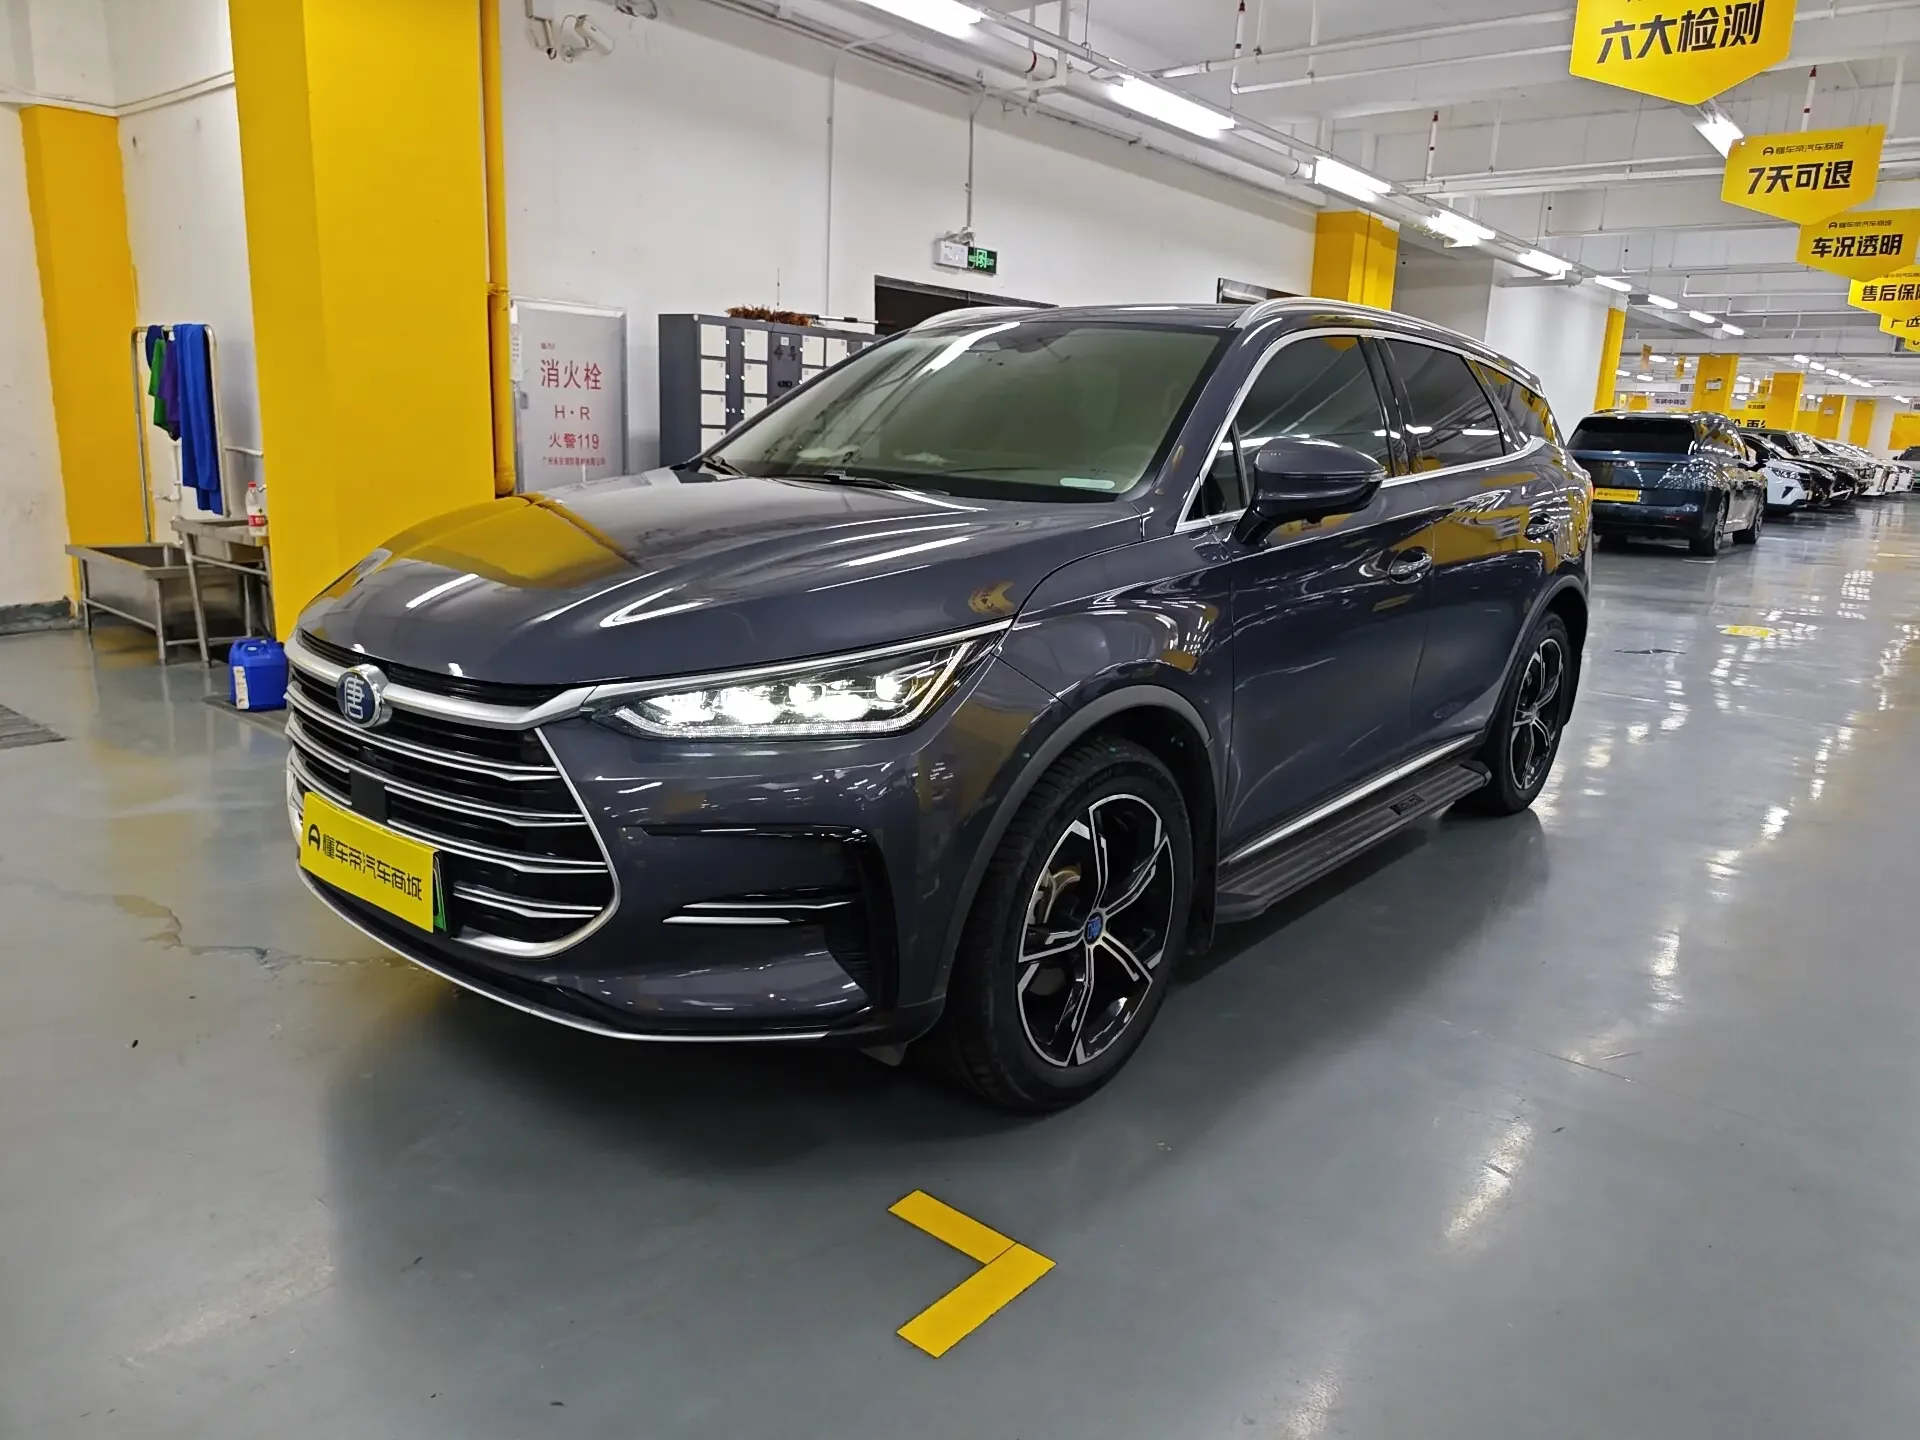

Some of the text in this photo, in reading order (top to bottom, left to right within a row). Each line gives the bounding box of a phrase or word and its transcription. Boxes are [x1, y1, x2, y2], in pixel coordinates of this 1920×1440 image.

[1597, 0, 1764, 64] 六大检测
[1748, 160, 1854, 194] 7天可退
[1811, 234, 1903, 258] 车况透明
[541, 358, 602, 390] 消火栓
[549, 432, 600, 450] 火警119
[323, 834, 423, 901] 懂车帝汽车商城
